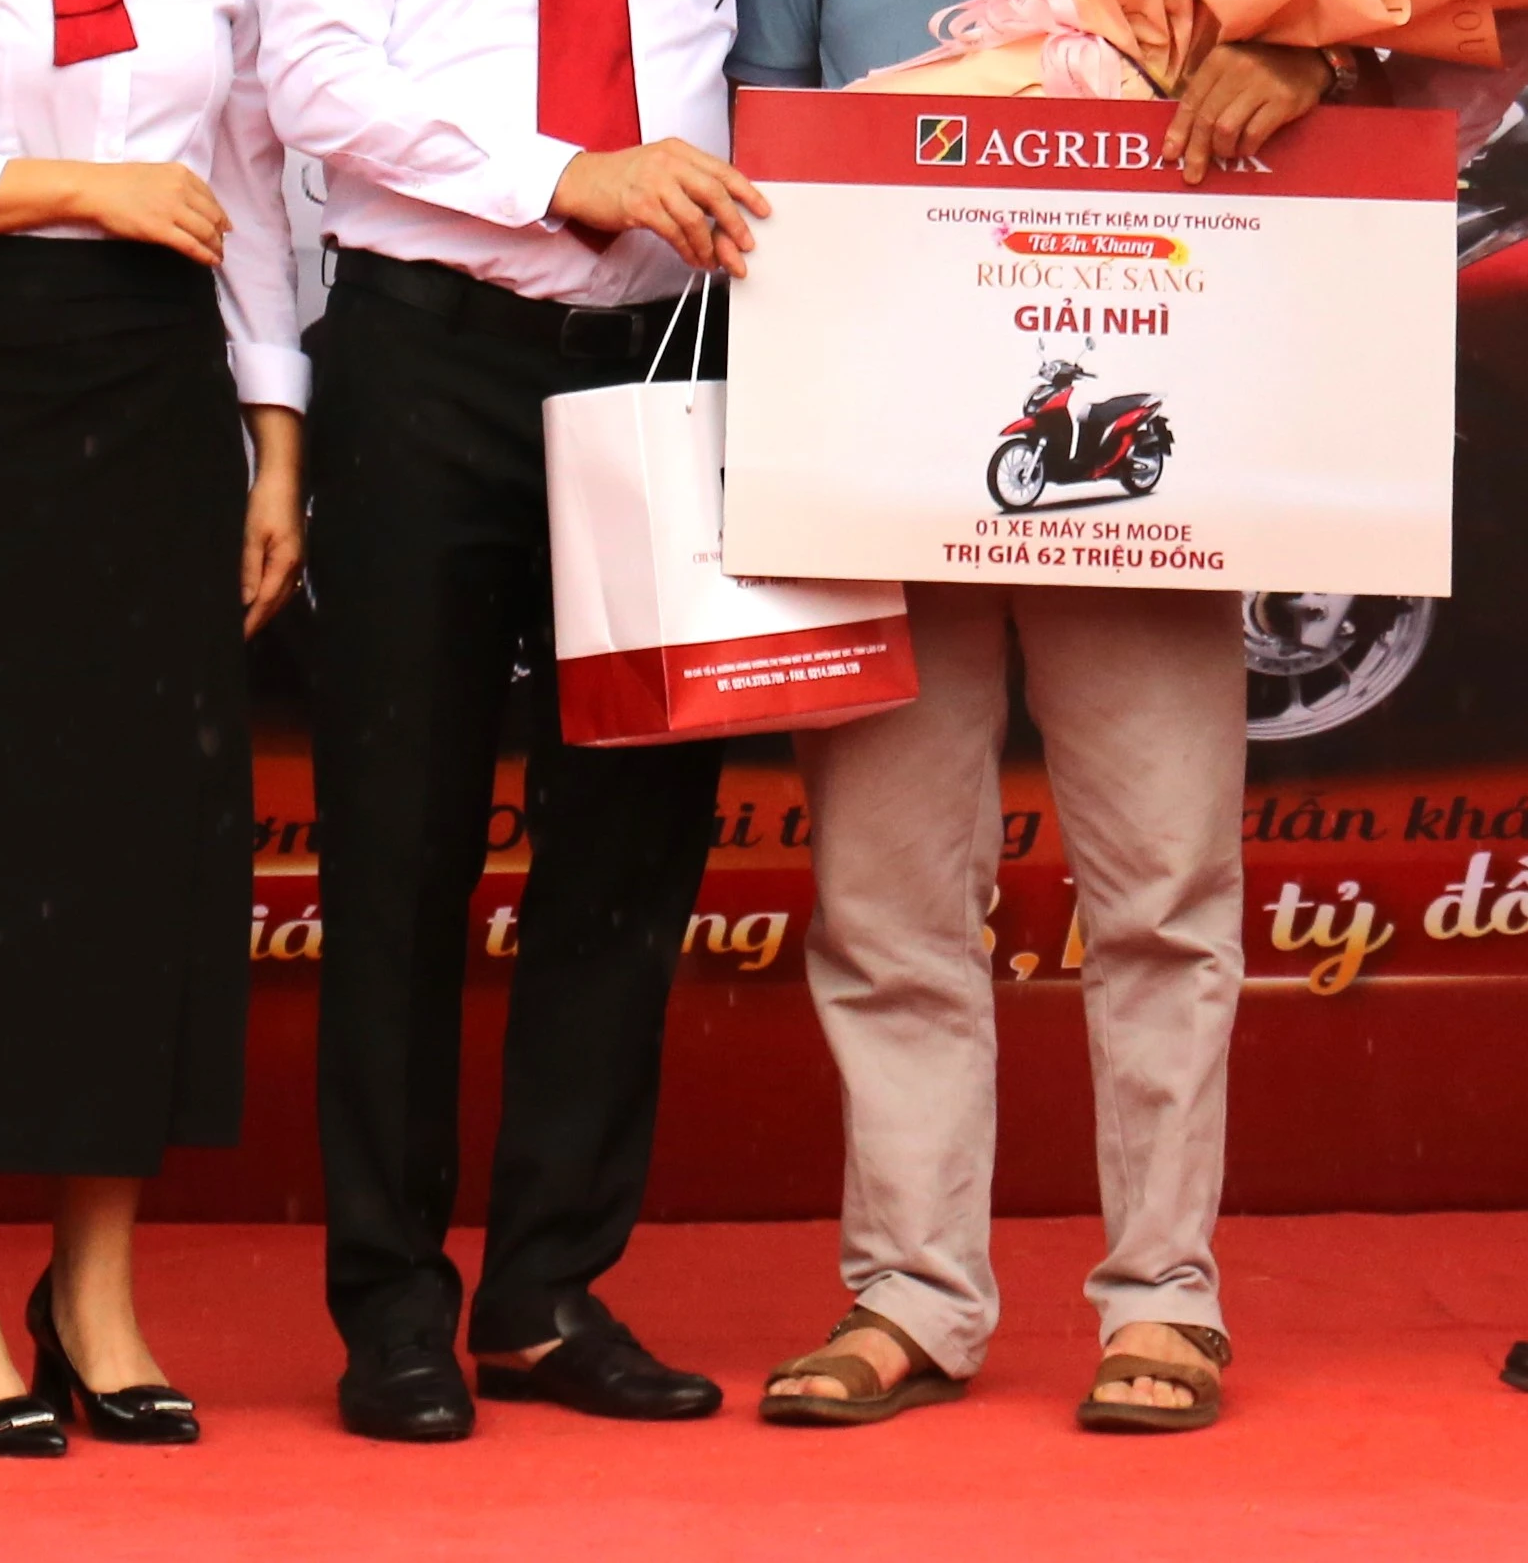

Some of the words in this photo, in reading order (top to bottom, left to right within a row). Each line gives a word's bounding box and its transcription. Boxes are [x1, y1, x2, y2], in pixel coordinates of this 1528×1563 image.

[975, 128, 1274, 174] AGRIB
[927, 207, 1004, 223] CHƯƠNG
[1008, 208, 1061, 225] TRÌNH
[1065, 209, 1102, 226] TIẾT
[1106, 212, 1149, 230] KIỆM
[1153, 213, 1182, 231] DỰ
[1184, 213, 1260, 230] THƯỞNG
[1091, 236, 1155, 258] Khang
[977, 259, 1064, 289] RƯỚC
[1123, 266, 1205, 293] SANG
[1014, 297, 1092, 333] GIẢI
[1103, 302, 1169, 336] NHÌ
[976, 519, 999, 536] 01
[1007, 520, 1033, 537] XE
[1039, 517, 1086, 538] MÁY
[1092, 522, 1120, 539] SH
[1127, 523, 1192, 542] MODE
[943, 543, 981, 569] TRỊ
[987, 541, 1030, 565] GIÁ
[1037, 547, 1066, 566] 62
[1072, 544, 1143, 573] TRIỆU
[1262, 880, 1395, 996] tỷ
